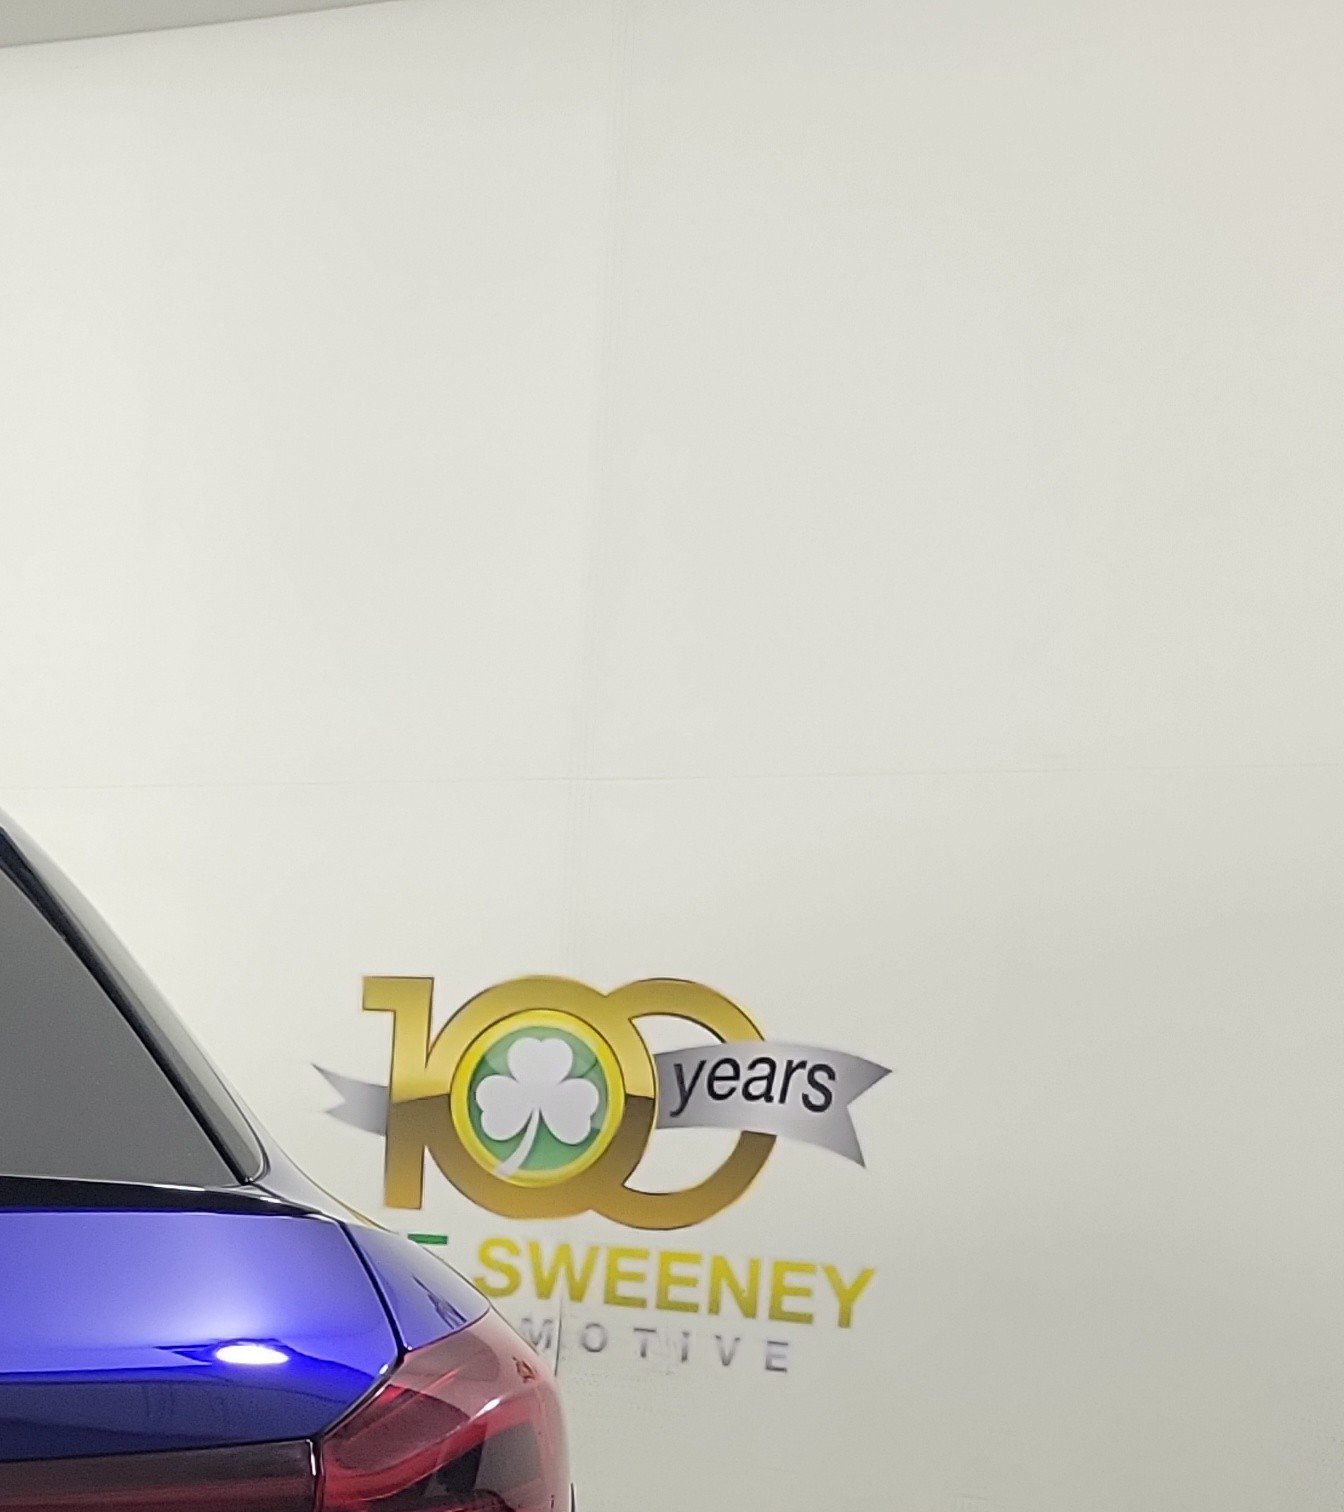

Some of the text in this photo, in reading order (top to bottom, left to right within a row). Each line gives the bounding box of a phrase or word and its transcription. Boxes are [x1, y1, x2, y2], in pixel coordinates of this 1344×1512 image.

[362, 975, 777, 1230] 100
[669, 1056, 837, 1118] years
[474, 1236, 876, 1330] SWEENEY
[520, 1317, 789, 1373] MOTIVE
